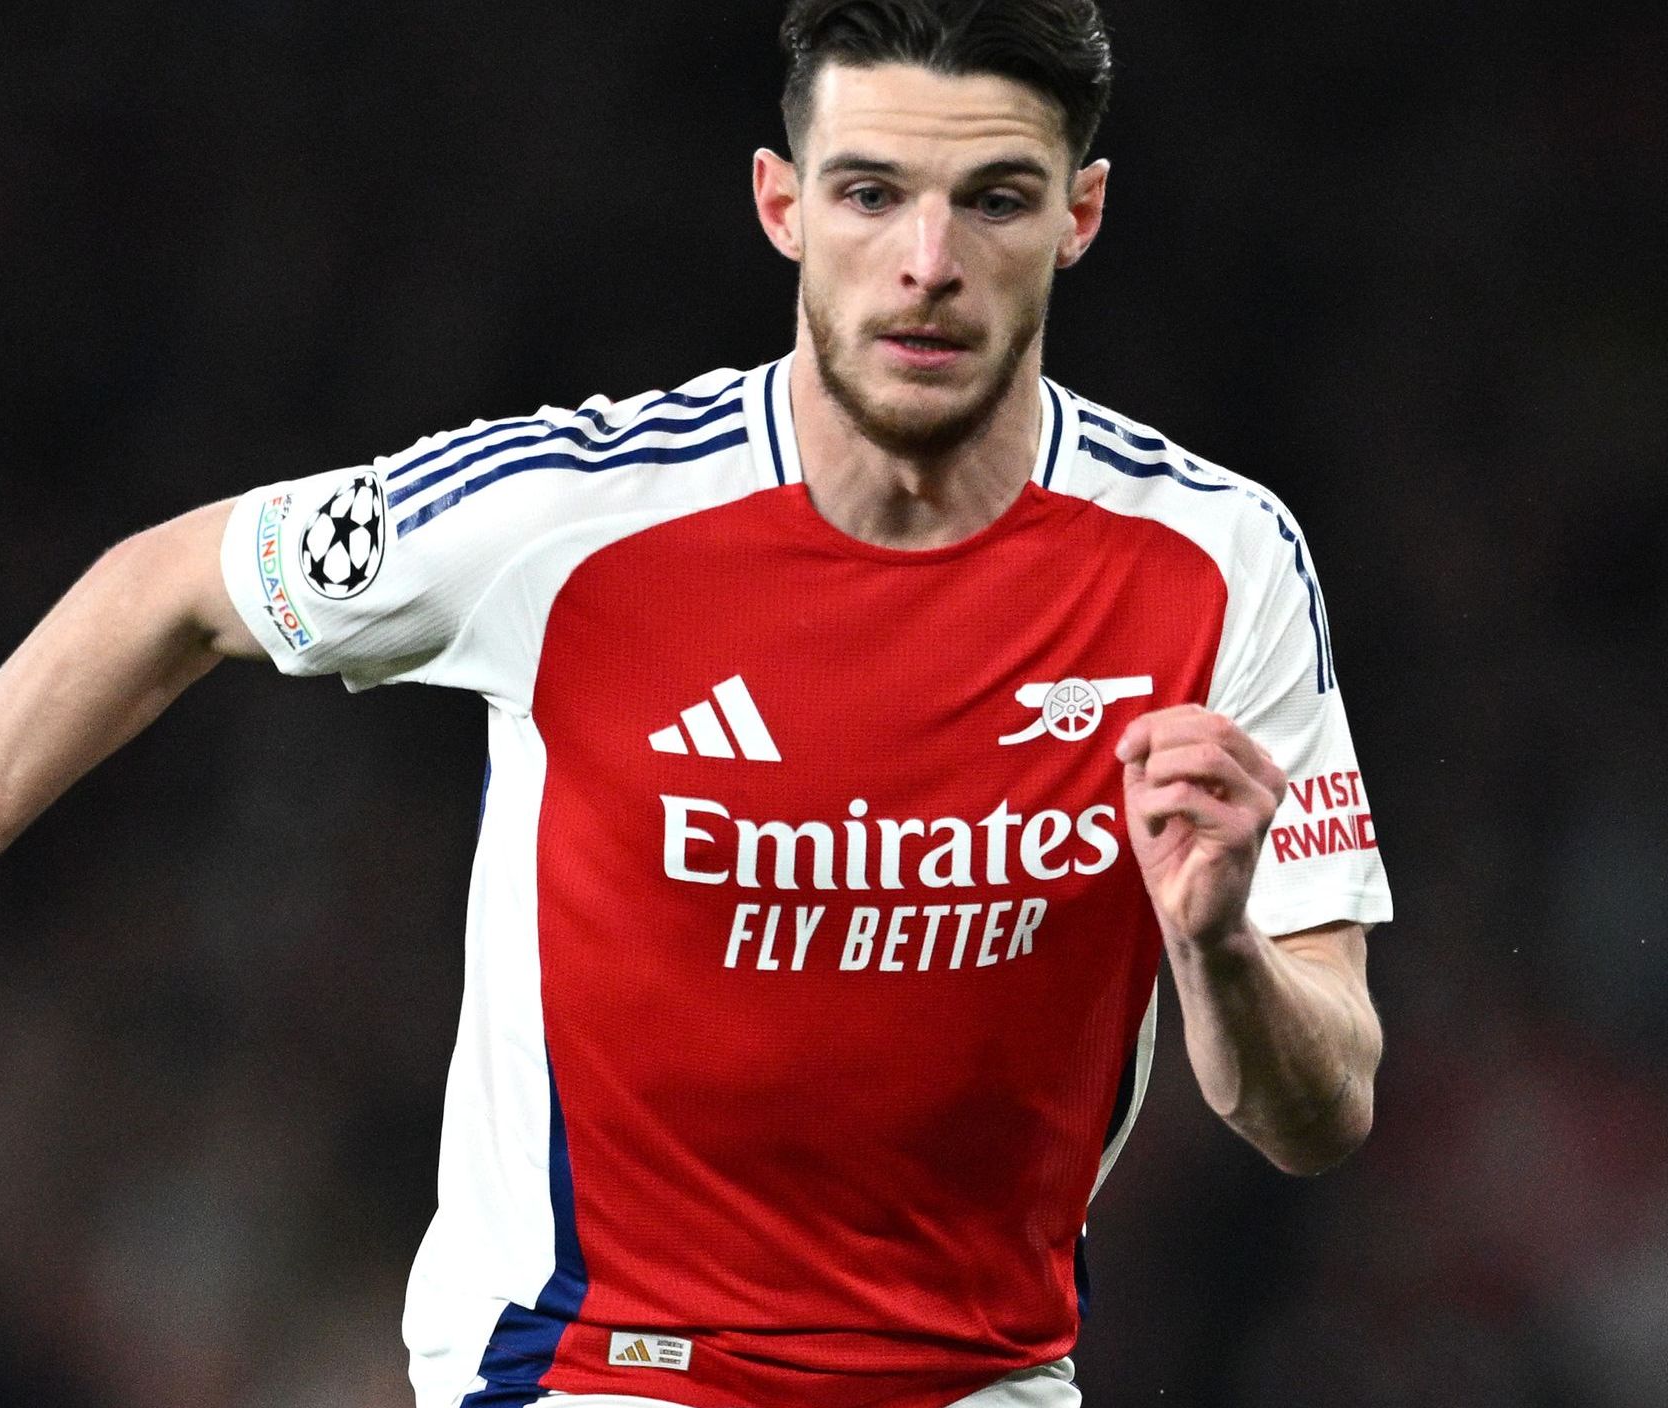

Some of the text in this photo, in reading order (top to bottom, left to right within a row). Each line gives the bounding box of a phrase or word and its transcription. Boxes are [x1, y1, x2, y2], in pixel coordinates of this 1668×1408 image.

[262, 496, 310, 646] FOUNDATION
[1288, 771, 1360, 815] VIST
[659, 795, 1119, 890] Emirates
[723, 898, 1048, 972] FLY BETTER
